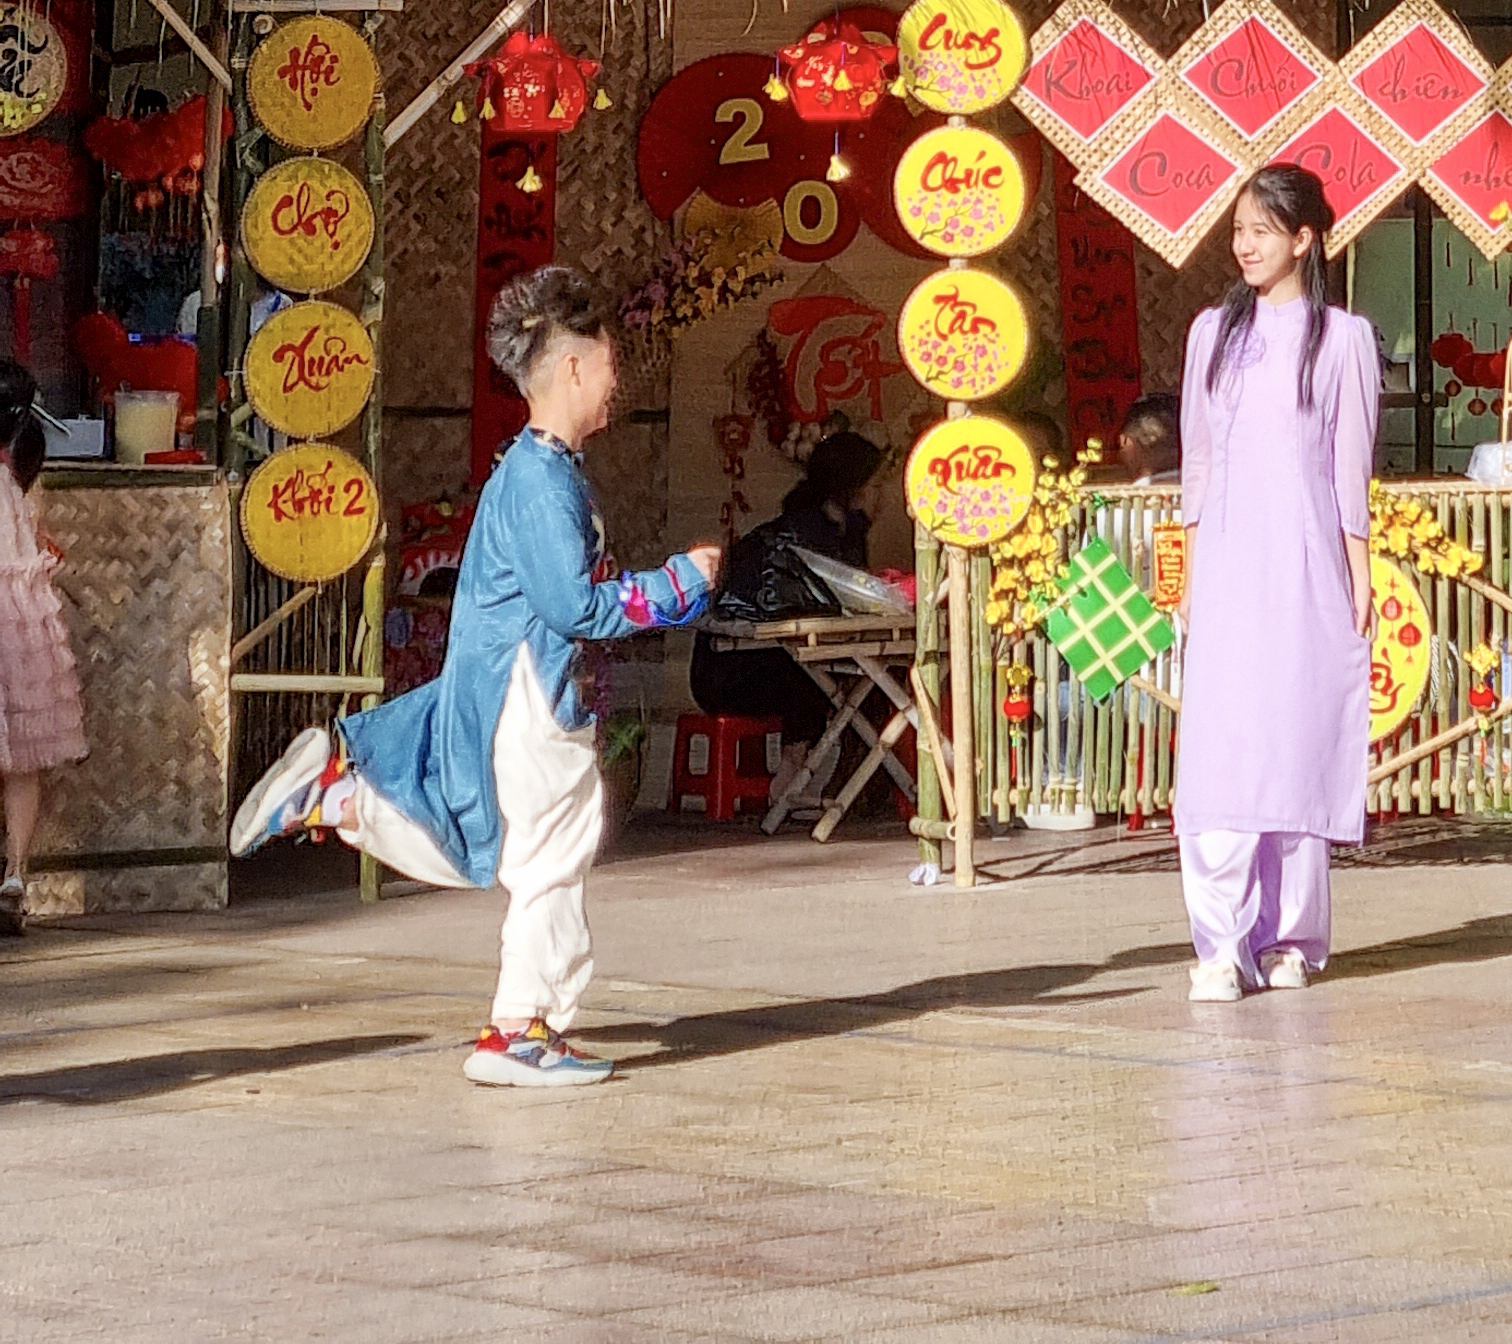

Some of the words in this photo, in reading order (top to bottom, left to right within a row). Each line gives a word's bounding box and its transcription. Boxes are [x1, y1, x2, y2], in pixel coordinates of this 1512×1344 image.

[917, 11, 1003, 71] Cung
[277, 33, 341, 112] Hội
[1042, 48, 1134, 104] Khoai
[1377, 52, 1465, 103] chiên
[714, 97, 770, 166] 2
[782, 179, 839, 245] 0
[920, 149, 1005, 194] Chúc
[1128, 150, 1215, 198] Coca
[1294, 138, 1377, 193] Cola
[270, 181, 351, 251] Chợ
[932, 283, 998, 342] Tân
[271, 323, 370, 394] Xuân
[266, 458, 339, 524] Khối
[342, 477, 367, 517] 2
[927, 443, 1017, 497] Xuân
